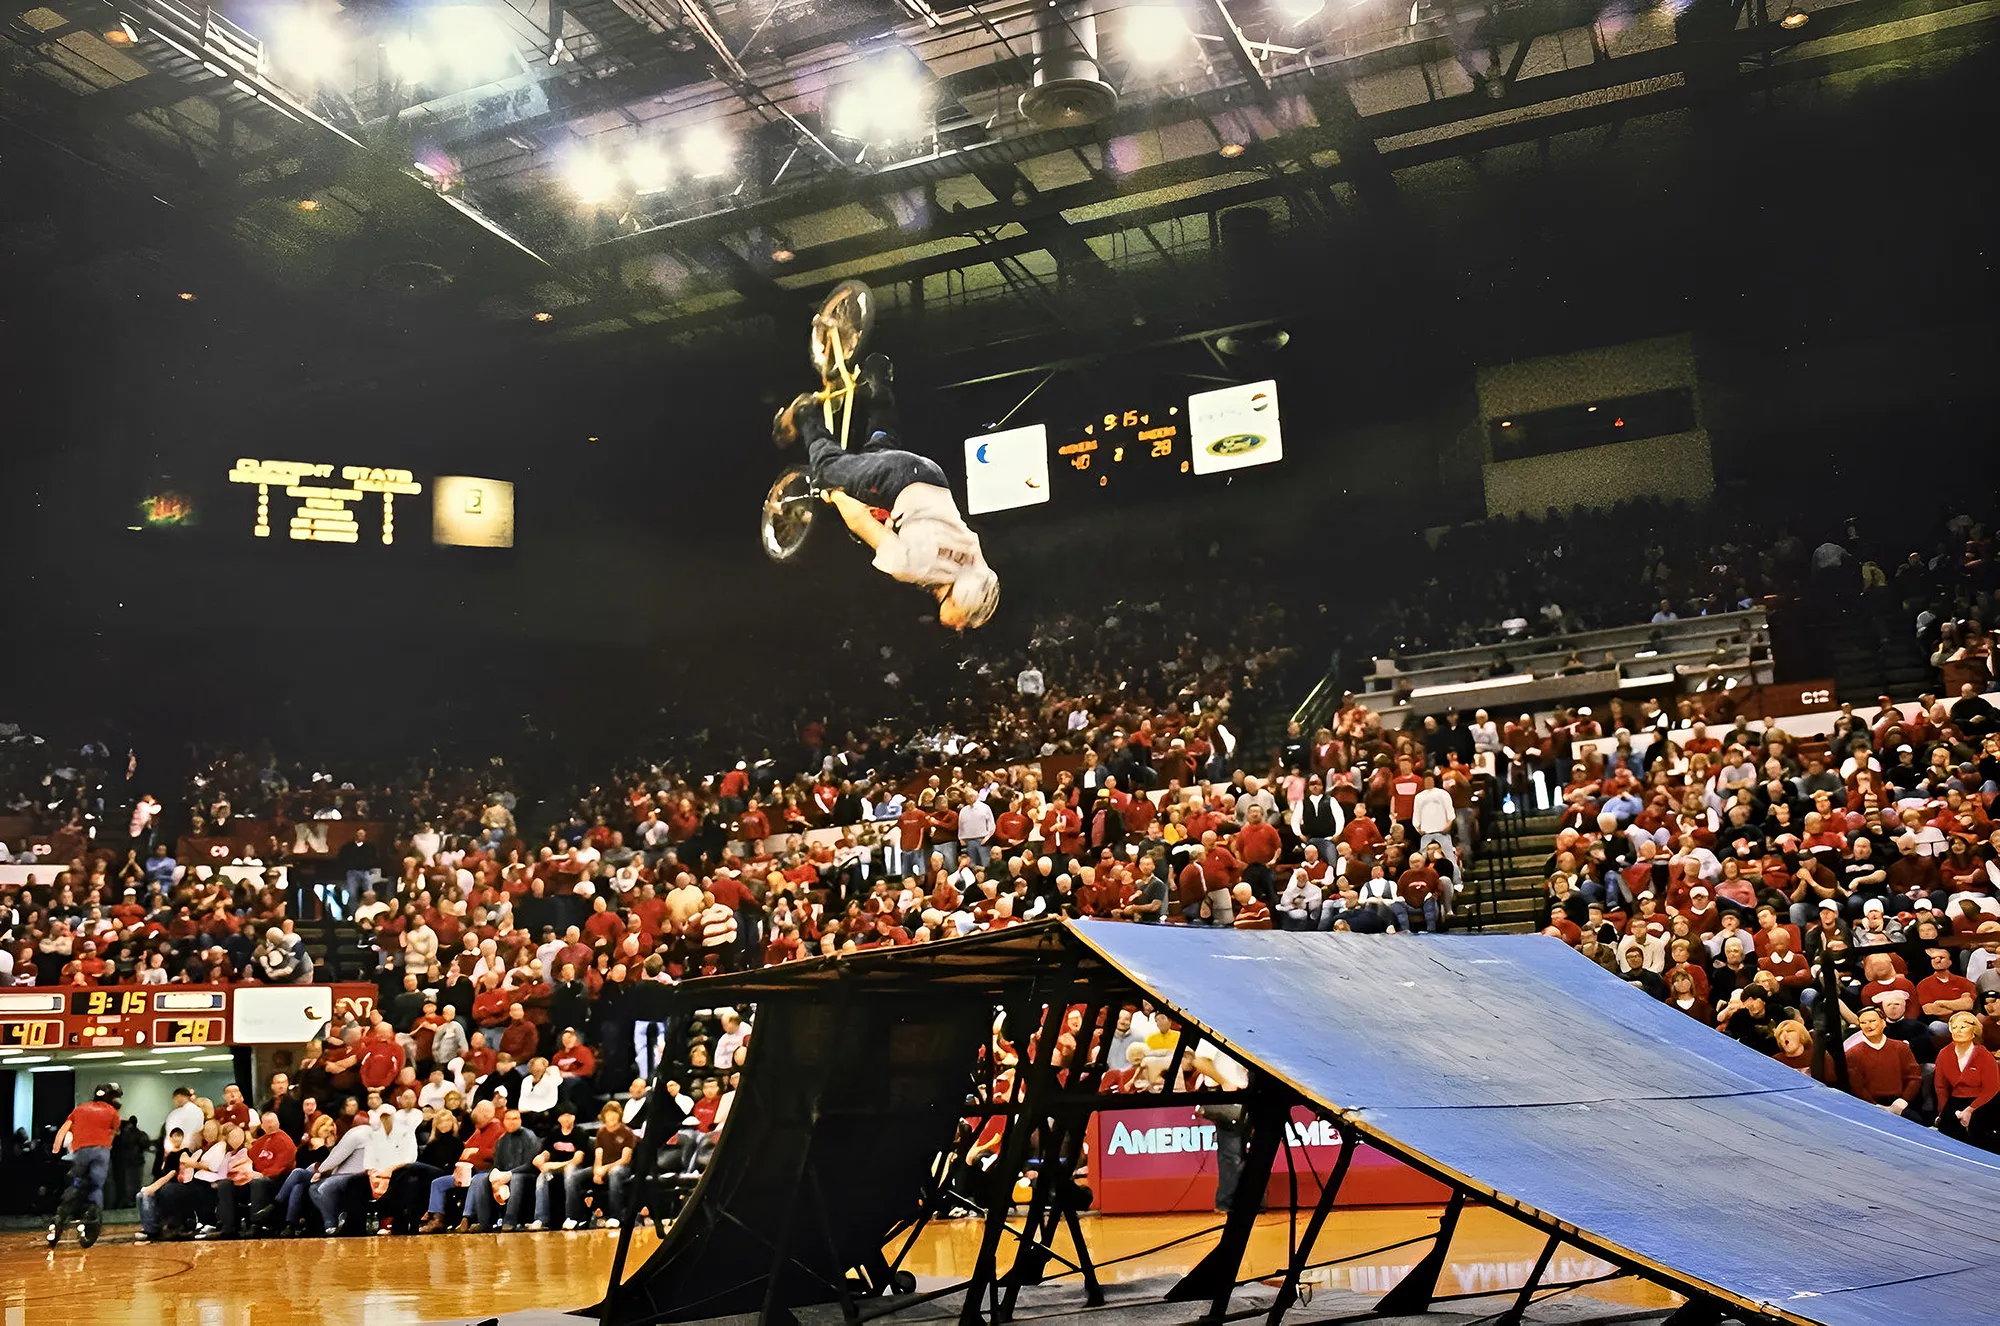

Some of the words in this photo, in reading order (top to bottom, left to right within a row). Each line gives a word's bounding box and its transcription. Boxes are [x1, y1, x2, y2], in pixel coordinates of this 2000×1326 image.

[1801, 690, 1829, 705] C12
[293, 822, 329, 853] N
[87, 991, 147, 1015] 9:15
[11, 1021, 47, 1046] 40
[174, 1019, 211, 1043] 28
[1107, 1120, 1218, 1155] AMERIT
